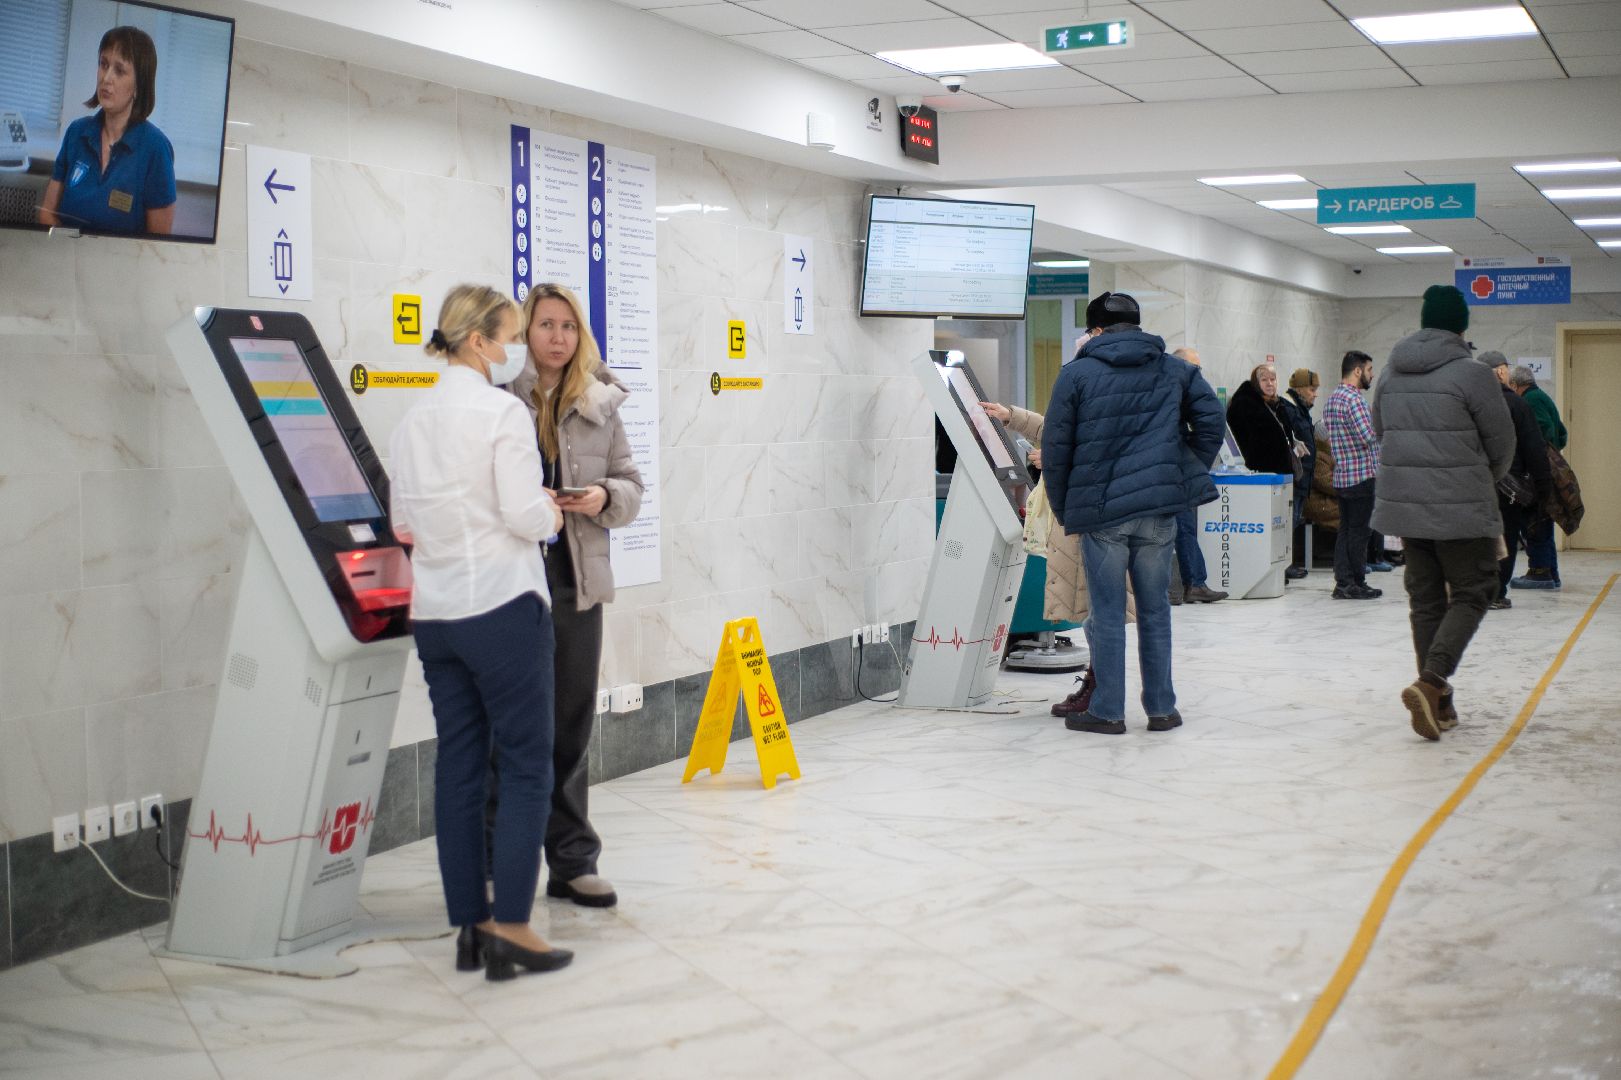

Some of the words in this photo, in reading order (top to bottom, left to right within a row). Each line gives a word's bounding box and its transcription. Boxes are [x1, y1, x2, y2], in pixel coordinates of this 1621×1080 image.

[517, 141, 524, 167] 1
[592, 156, 602, 181] 2
[1348, 197, 1435, 213] ГАРДЕРОБ
[1497, 273, 1555, 282] ГОСУДАРСТВЕННЫЙ
[1497, 282, 1529, 291] АПТЕЧНЫЙ
[1497, 292, 1517, 300] ПУНКТ
[374, 375, 405, 384] СОБЛЮДАЙТЕ
[1204, 522, 1265, 533] EXPRESS
[762, 721, 782, 735] CAUTION
[763, 734, 773, 745] WET
[773, 730, 786, 741] FLOOR
